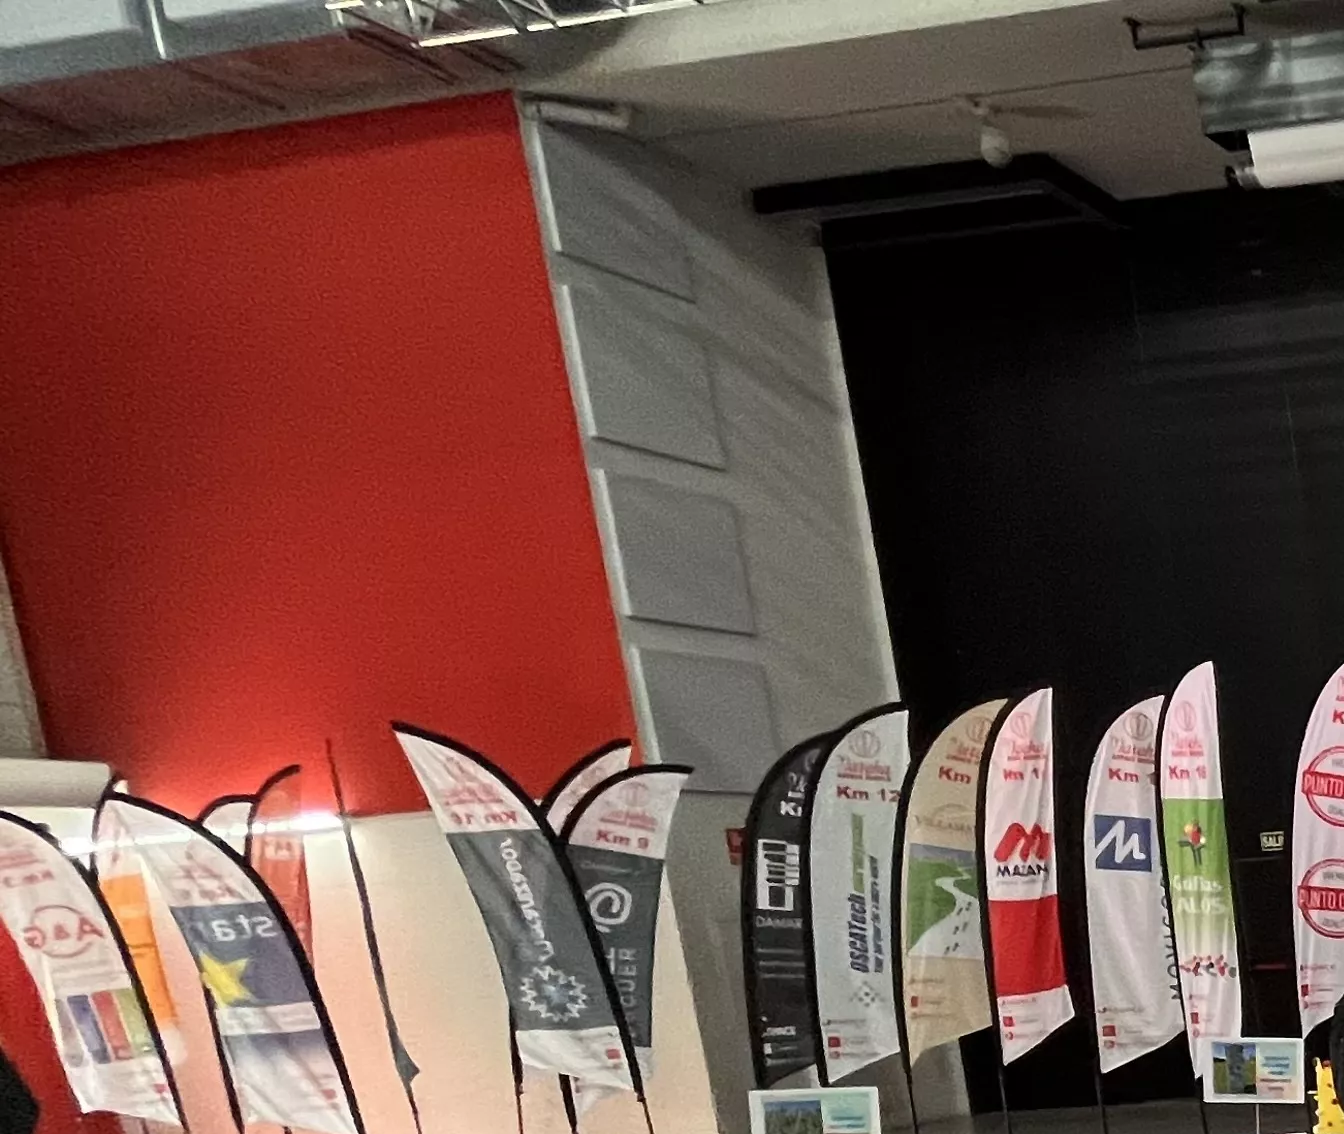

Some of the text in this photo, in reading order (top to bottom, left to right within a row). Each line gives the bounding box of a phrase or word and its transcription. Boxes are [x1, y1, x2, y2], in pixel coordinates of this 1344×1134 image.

[937, 765, 973, 786] Km
[1107, 767, 1140, 783] Km
[1168, 765, 1191, 780] Km
[836, 784, 870, 801] Km
[1303, 773, 1344, 799] PUNTO
[595, 829, 631, 846] Km
